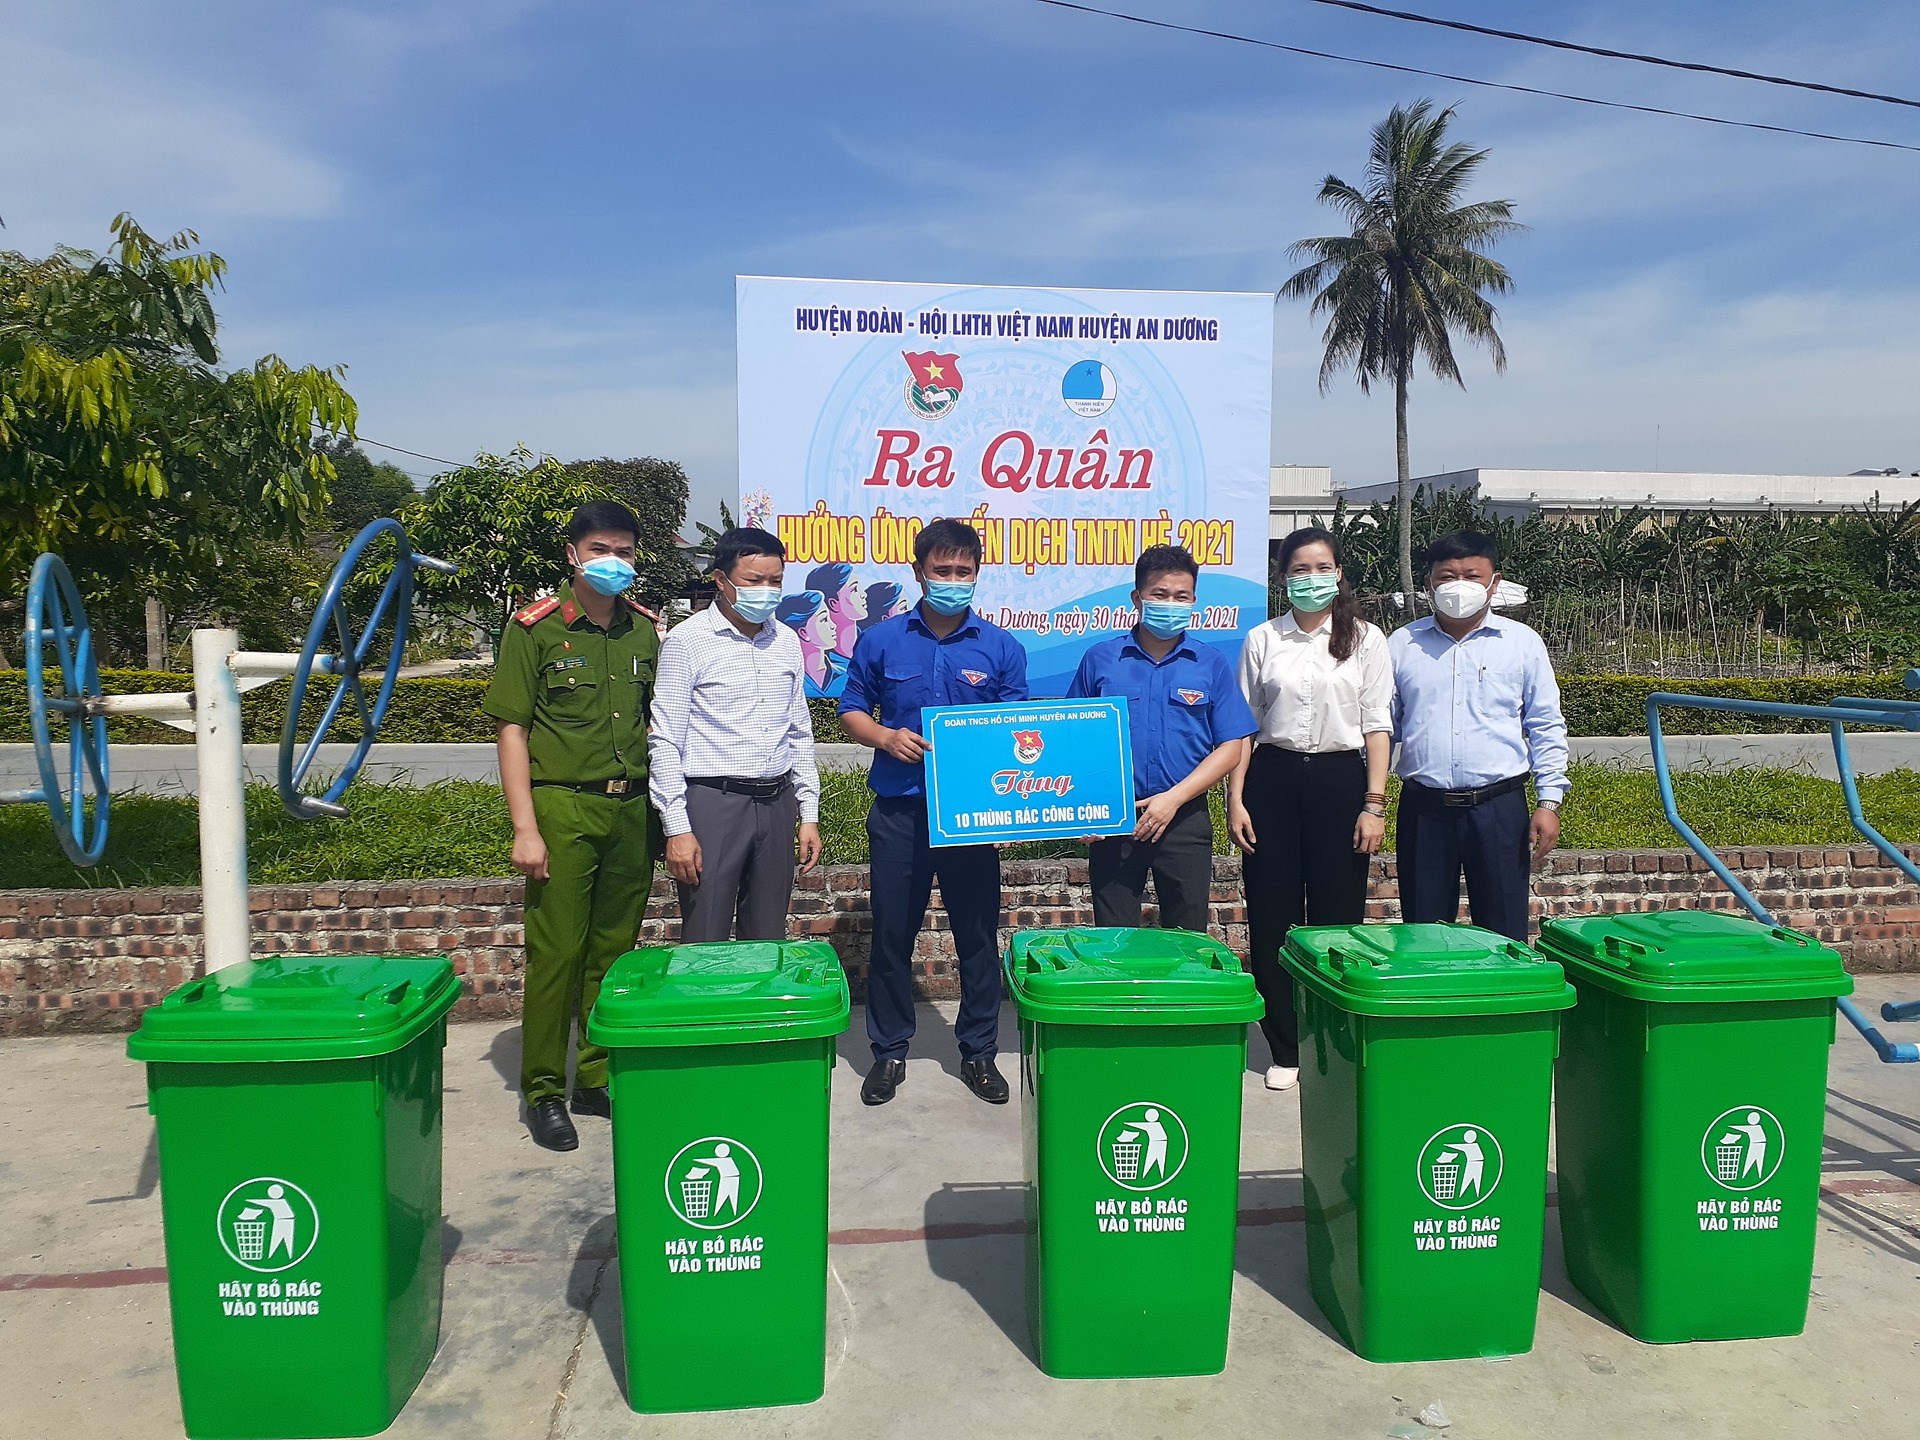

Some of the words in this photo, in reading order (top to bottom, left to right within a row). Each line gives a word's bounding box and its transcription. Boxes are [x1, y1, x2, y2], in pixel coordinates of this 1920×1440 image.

[796, 304, 852, 336] HUYỆN
[857, 306, 902, 334] ĐOÀN
[919, 308, 947, 339] HỘI
[952, 312, 992, 337] LHTH
[997, 310, 1031, 342] VIỆT
[1035, 316, 1073, 338] NAM
[1078, 312, 1132, 343] HUYỆN
[1136, 317, 1159, 340] AN
[1163, 315, 1219, 342] DƯƠNG
[863, 429, 955, 488] Ra
[981, 429, 1154, 493] Quân
[777, 500, 865, 564] HƯỞNG
[1010, 517, 1067, 575] DỊCH
[1072, 518, 1136, 565] TNTN
[1178, 519, 1234, 566] 2021
[1000, 607, 1050, 634] Dương,
[1055, 607, 1088, 634] ngày
[1091, 606, 1110, 629] 30
[1203, 606, 1238, 629] 2021
[944, 718, 967, 728] ĐOÀN
[968, 716, 989, 726] TNCS
[1003, 713, 1017, 724] CHÍ
[1018, 714, 1038, 723] MINH
[1039, 712, 1066, 722] HUYỆN
[1067, 712, 1078, 720] AN
[1080, 710, 1107, 720] DƯƠNG
[991, 770, 1074, 800] Tặng
[955, 813, 970, 828] 10
[972, 808, 1013, 827] THÙNG
[1015, 805, 1040, 825] RÁC
[1042, 805, 1075, 822] CÔNG
[1077, 802, 1110, 824] CỘNG
[1095, 1198, 1127, 1215] HÃY
[1130, 1196, 1152, 1215] BỎ
[1156, 1197, 1188, 1214] RÁC
[1697, 1198, 1727, 1214] HÃY
[1730, 1196, 1750, 1214] BỎ
[1753, 1197, 1782, 1213] RÁC
[1098, 1215, 1130, 1232] VÀO
[1133, 1215, 1185, 1232] THÙNG
[1413, 1218, 1443, 1234] HÃY
[1447, 1215, 1468, 1233] BỎ
[1471, 1215, 1501, 1232] RÁC
[1699, 1215, 1729, 1231] VÀO
[1732, 1214, 1779, 1231] THÙNG
[665, 1238, 698, 1255] HÃY
[703, 1235, 725, 1254] BỎ
[729, 1234, 764, 1253] RÁC
[1416, 1235, 1446, 1251] VÀO
[1449, 1233, 1498, 1250] THÙNG
[668, 1256, 702, 1273] VÀO
[705, 1254, 762, 1273] THÙNG
[285, 1278, 322, 1298] RÁC
[222, 1298, 257, 1317] VÀO
